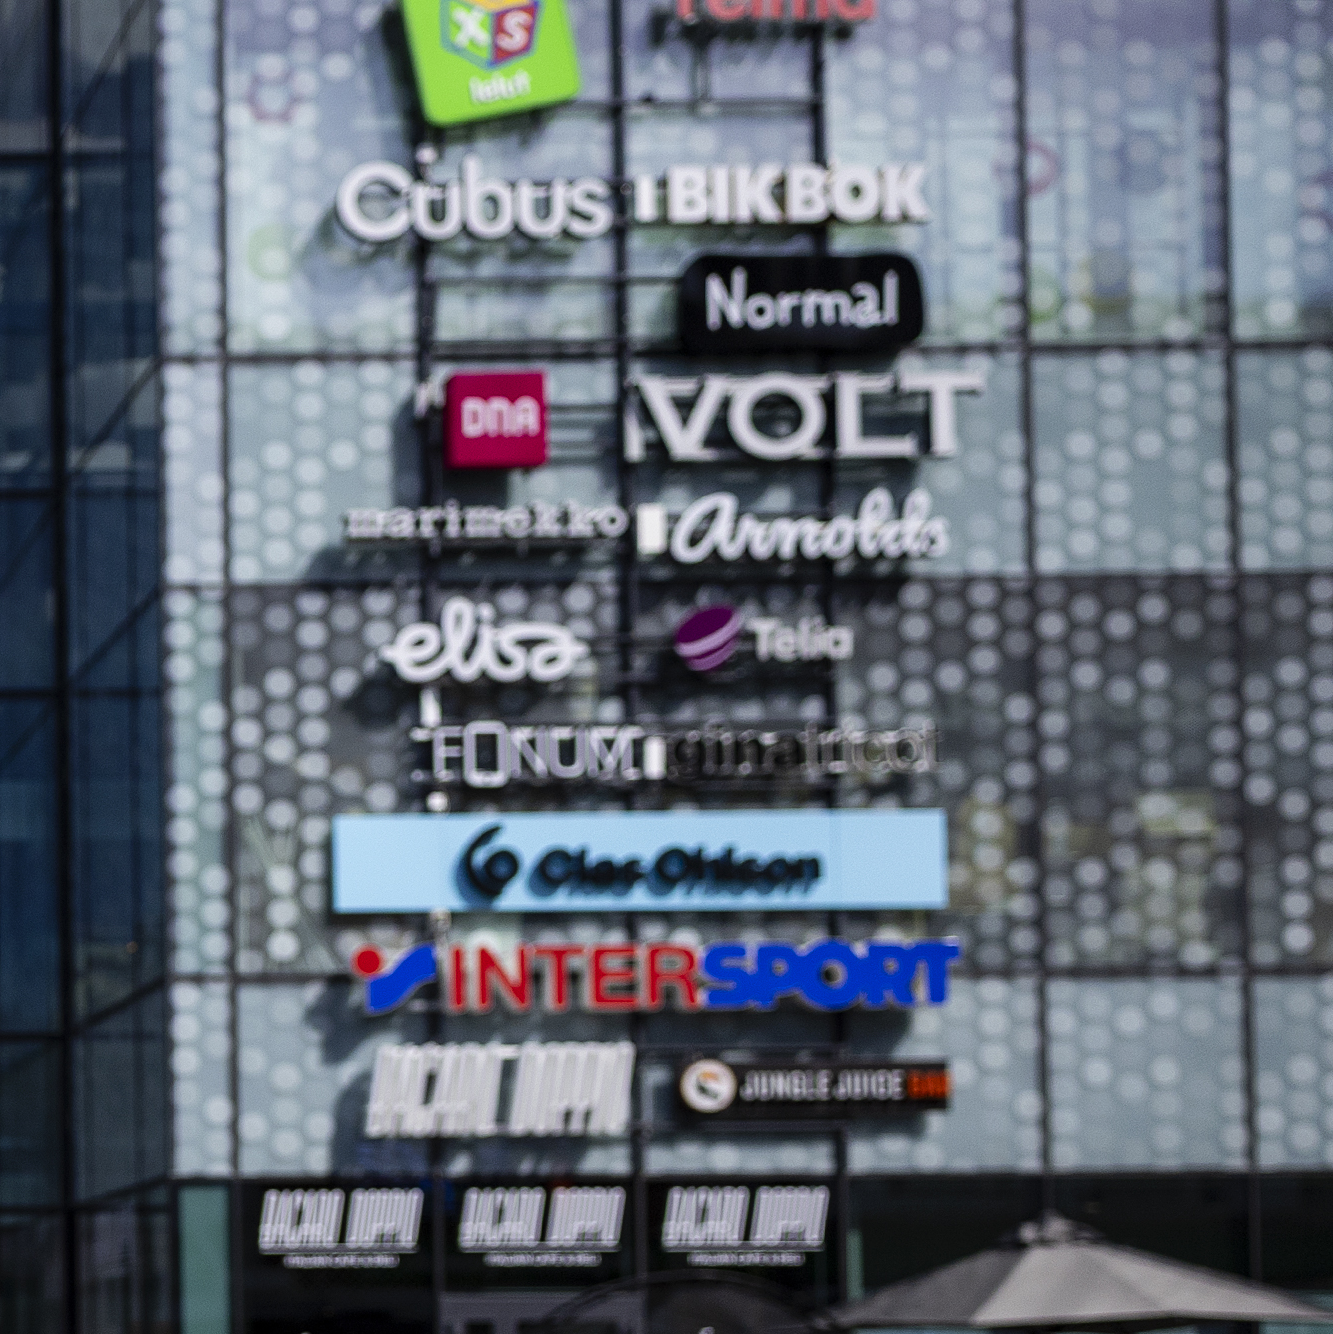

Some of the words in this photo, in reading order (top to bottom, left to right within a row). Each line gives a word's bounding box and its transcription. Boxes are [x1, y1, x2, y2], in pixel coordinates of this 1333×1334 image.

[336, 156, 615, 242] Cubus
[705, 267, 900, 329] Normal
[460, 395, 541, 438] DNA
[635, 370, 986, 461] VOLT
[344, 499, 631, 541] marimekko
[671, 488, 950, 564] Arnolds
[383, 596, 590, 682] elisa
[747, 616, 855, 662] Telia
[447, 936, 961, 1012] INTERSPORT
[740, 1069, 833, 1102] JUNGLE
[833, 1069, 907, 1102] JUICE
